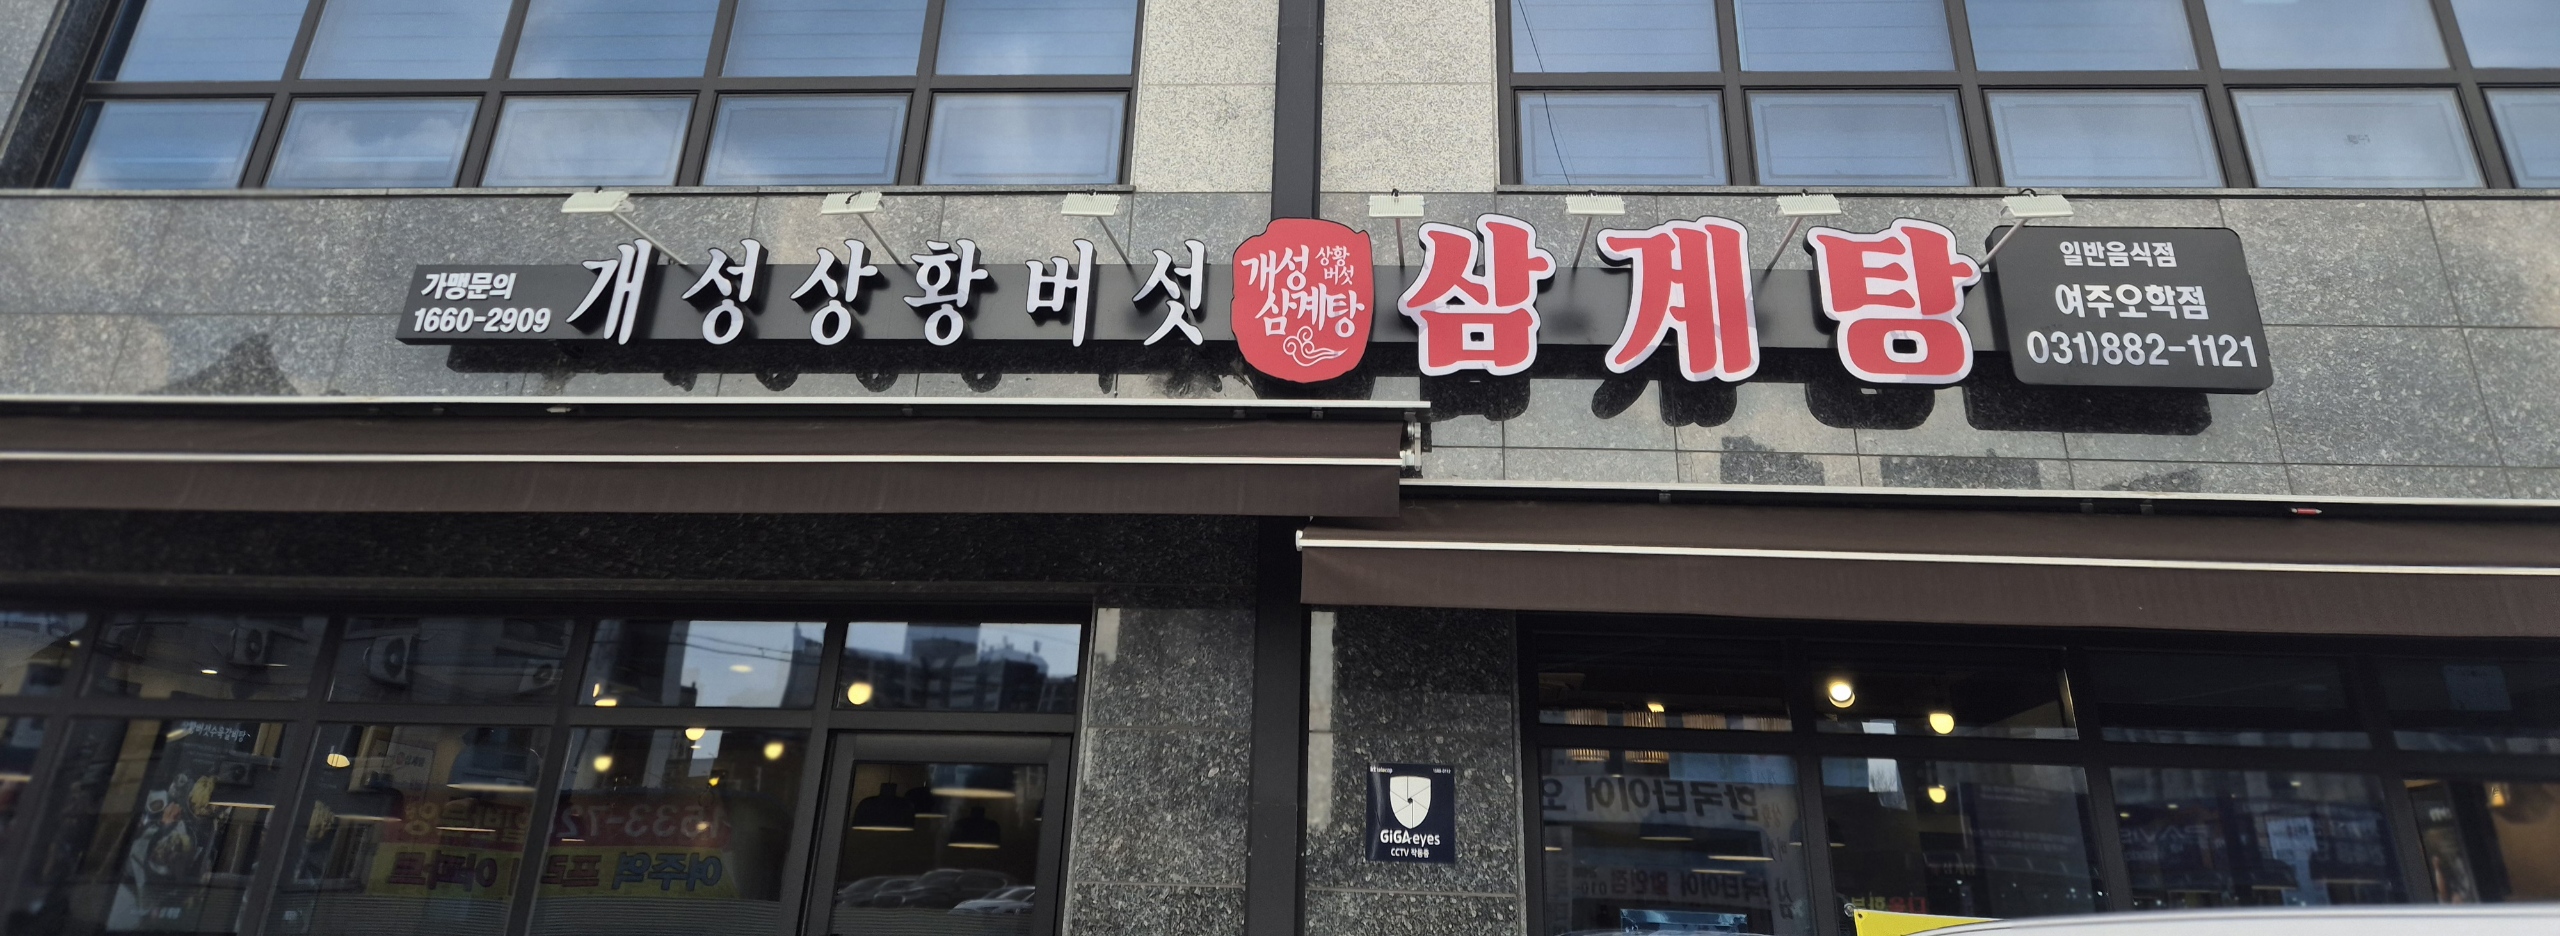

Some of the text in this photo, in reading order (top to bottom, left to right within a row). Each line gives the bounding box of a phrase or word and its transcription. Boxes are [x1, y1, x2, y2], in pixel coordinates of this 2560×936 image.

[1240, 244, 1309, 292] 개성
[1315, 245, 1350, 265] 상황
[2059, 241, 2178, 269] 일반음식점
[420, 271, 517, 301] 가맹문의
[1323, 265, 1355, 285] 버섯
[1254, 283, 1366, 338] 삼계탕
[1397, 213, 1981, 384] 삼계탕
[2054, 285, 2209, 321] 여주오학점
[411, 306, 552, 335] 1660-2909
[2025, 330, 2259, 369] 031)882-1121
[1391, 848, 1409, 857] CCTV
